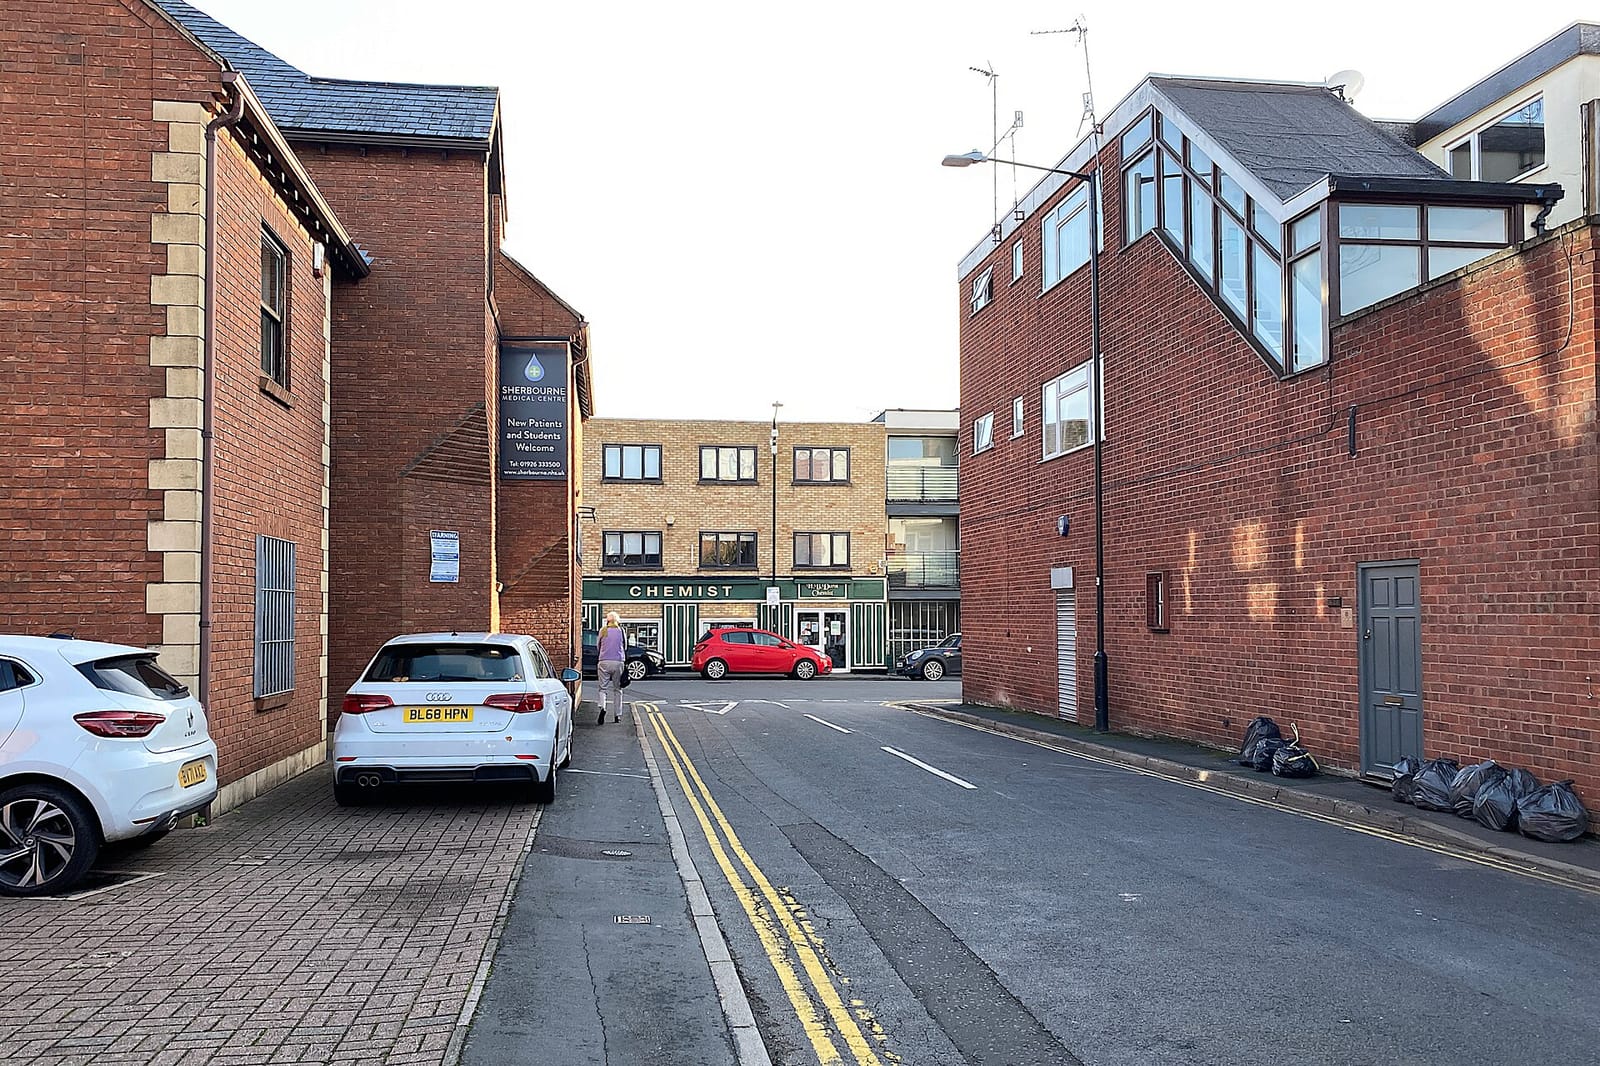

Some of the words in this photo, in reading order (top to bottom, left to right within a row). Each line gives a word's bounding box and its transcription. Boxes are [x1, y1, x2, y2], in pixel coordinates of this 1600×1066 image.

[502, 386, 566, 396] SHERBOURNE
[507, 418, 527, 427] New
[528, 419, 562, 428] Patients
[506, 430, 522, 439] and
[524, 430, 561, 440] Students
[515, 442, 555, 452] Welcome
[629, 585, 732, 597] CHEMIST
[409, 710, 442, 720] BL68
[444, 709, 468, 720] HPN
